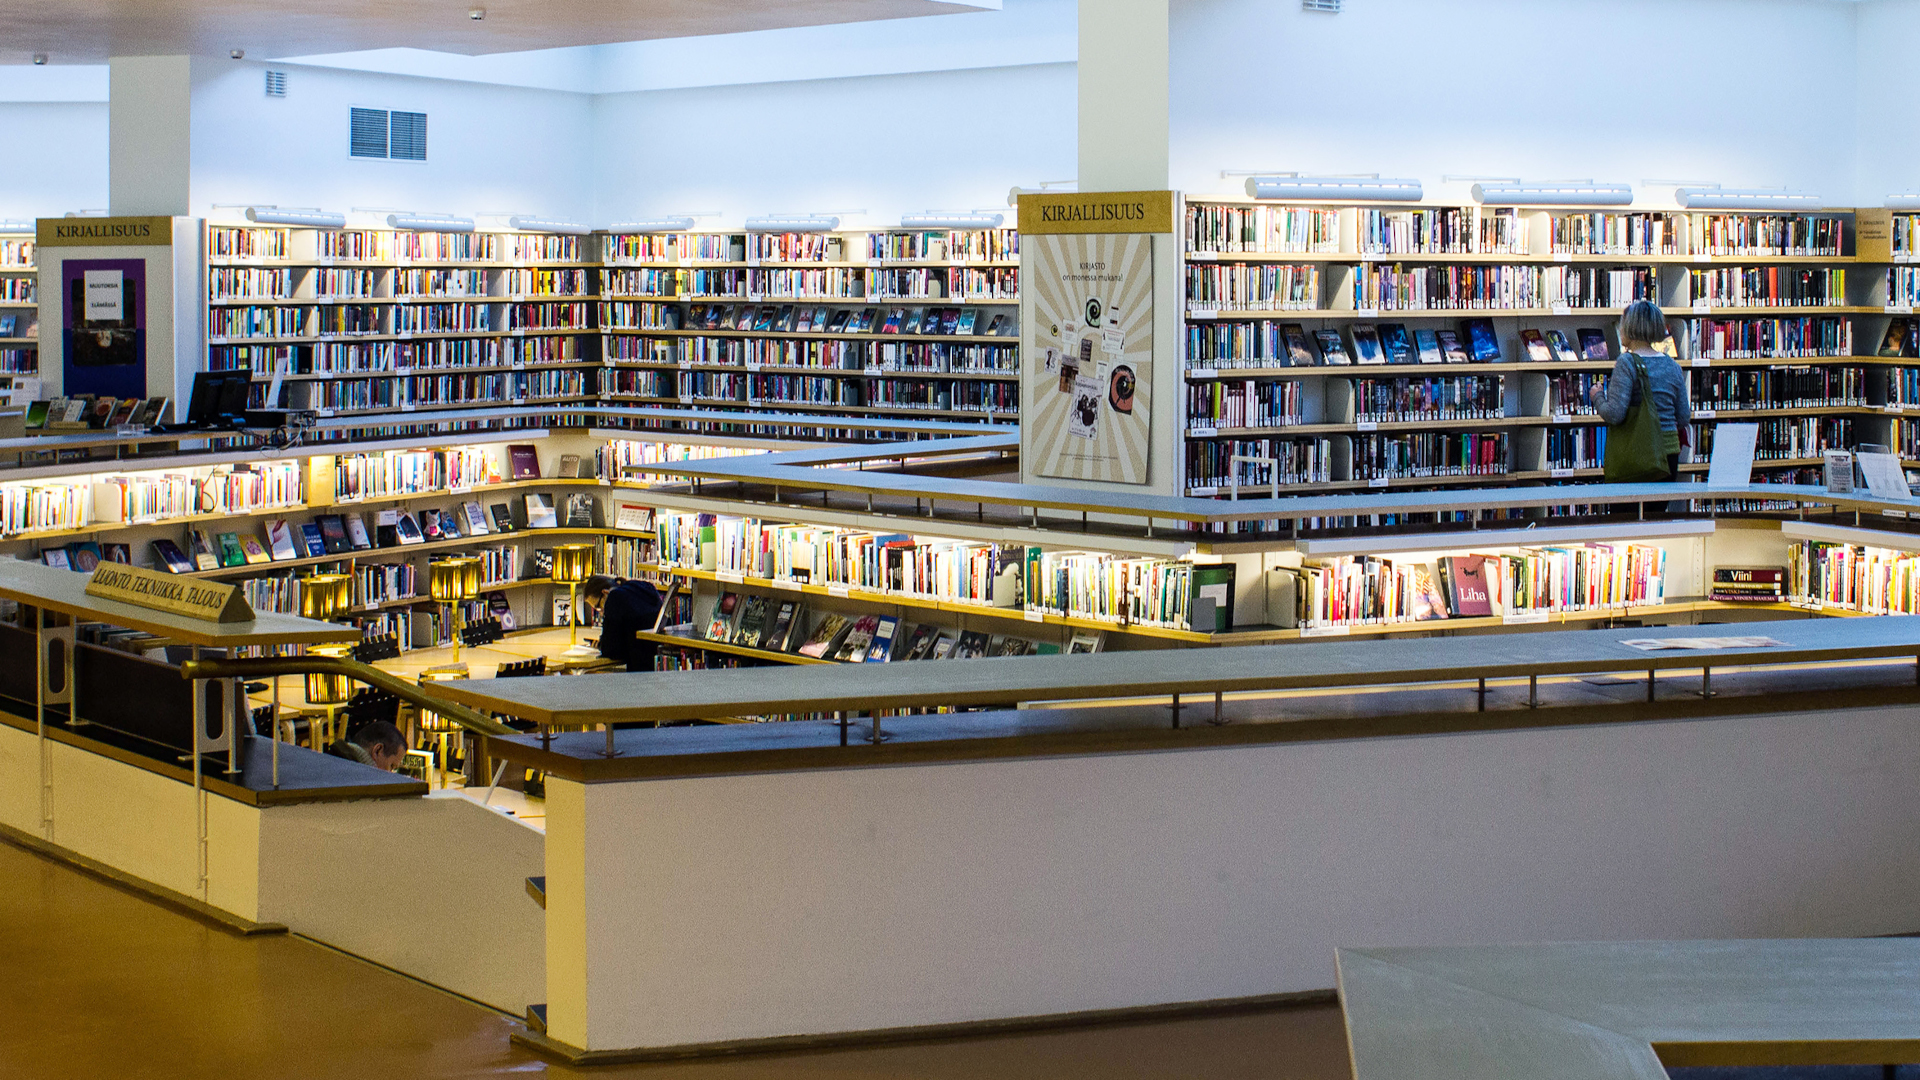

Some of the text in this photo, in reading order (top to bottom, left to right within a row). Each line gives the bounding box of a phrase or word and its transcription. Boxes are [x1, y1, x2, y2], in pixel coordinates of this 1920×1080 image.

[1042, 203, 1144, 221] KIRJALLISUUS
[56, 224, 150, 237] KIRJALLISUUS
[1079, 262, 1106, 271] KIRJASTO
[1098, 272, 1123, 281] mukana!
[1730, 570, 1752, 582] Viini
[92, 568, 226, 609] LUONTO. TEKNIIKKA. TALOUS
[1460, 587, 1487, 601] Liha
